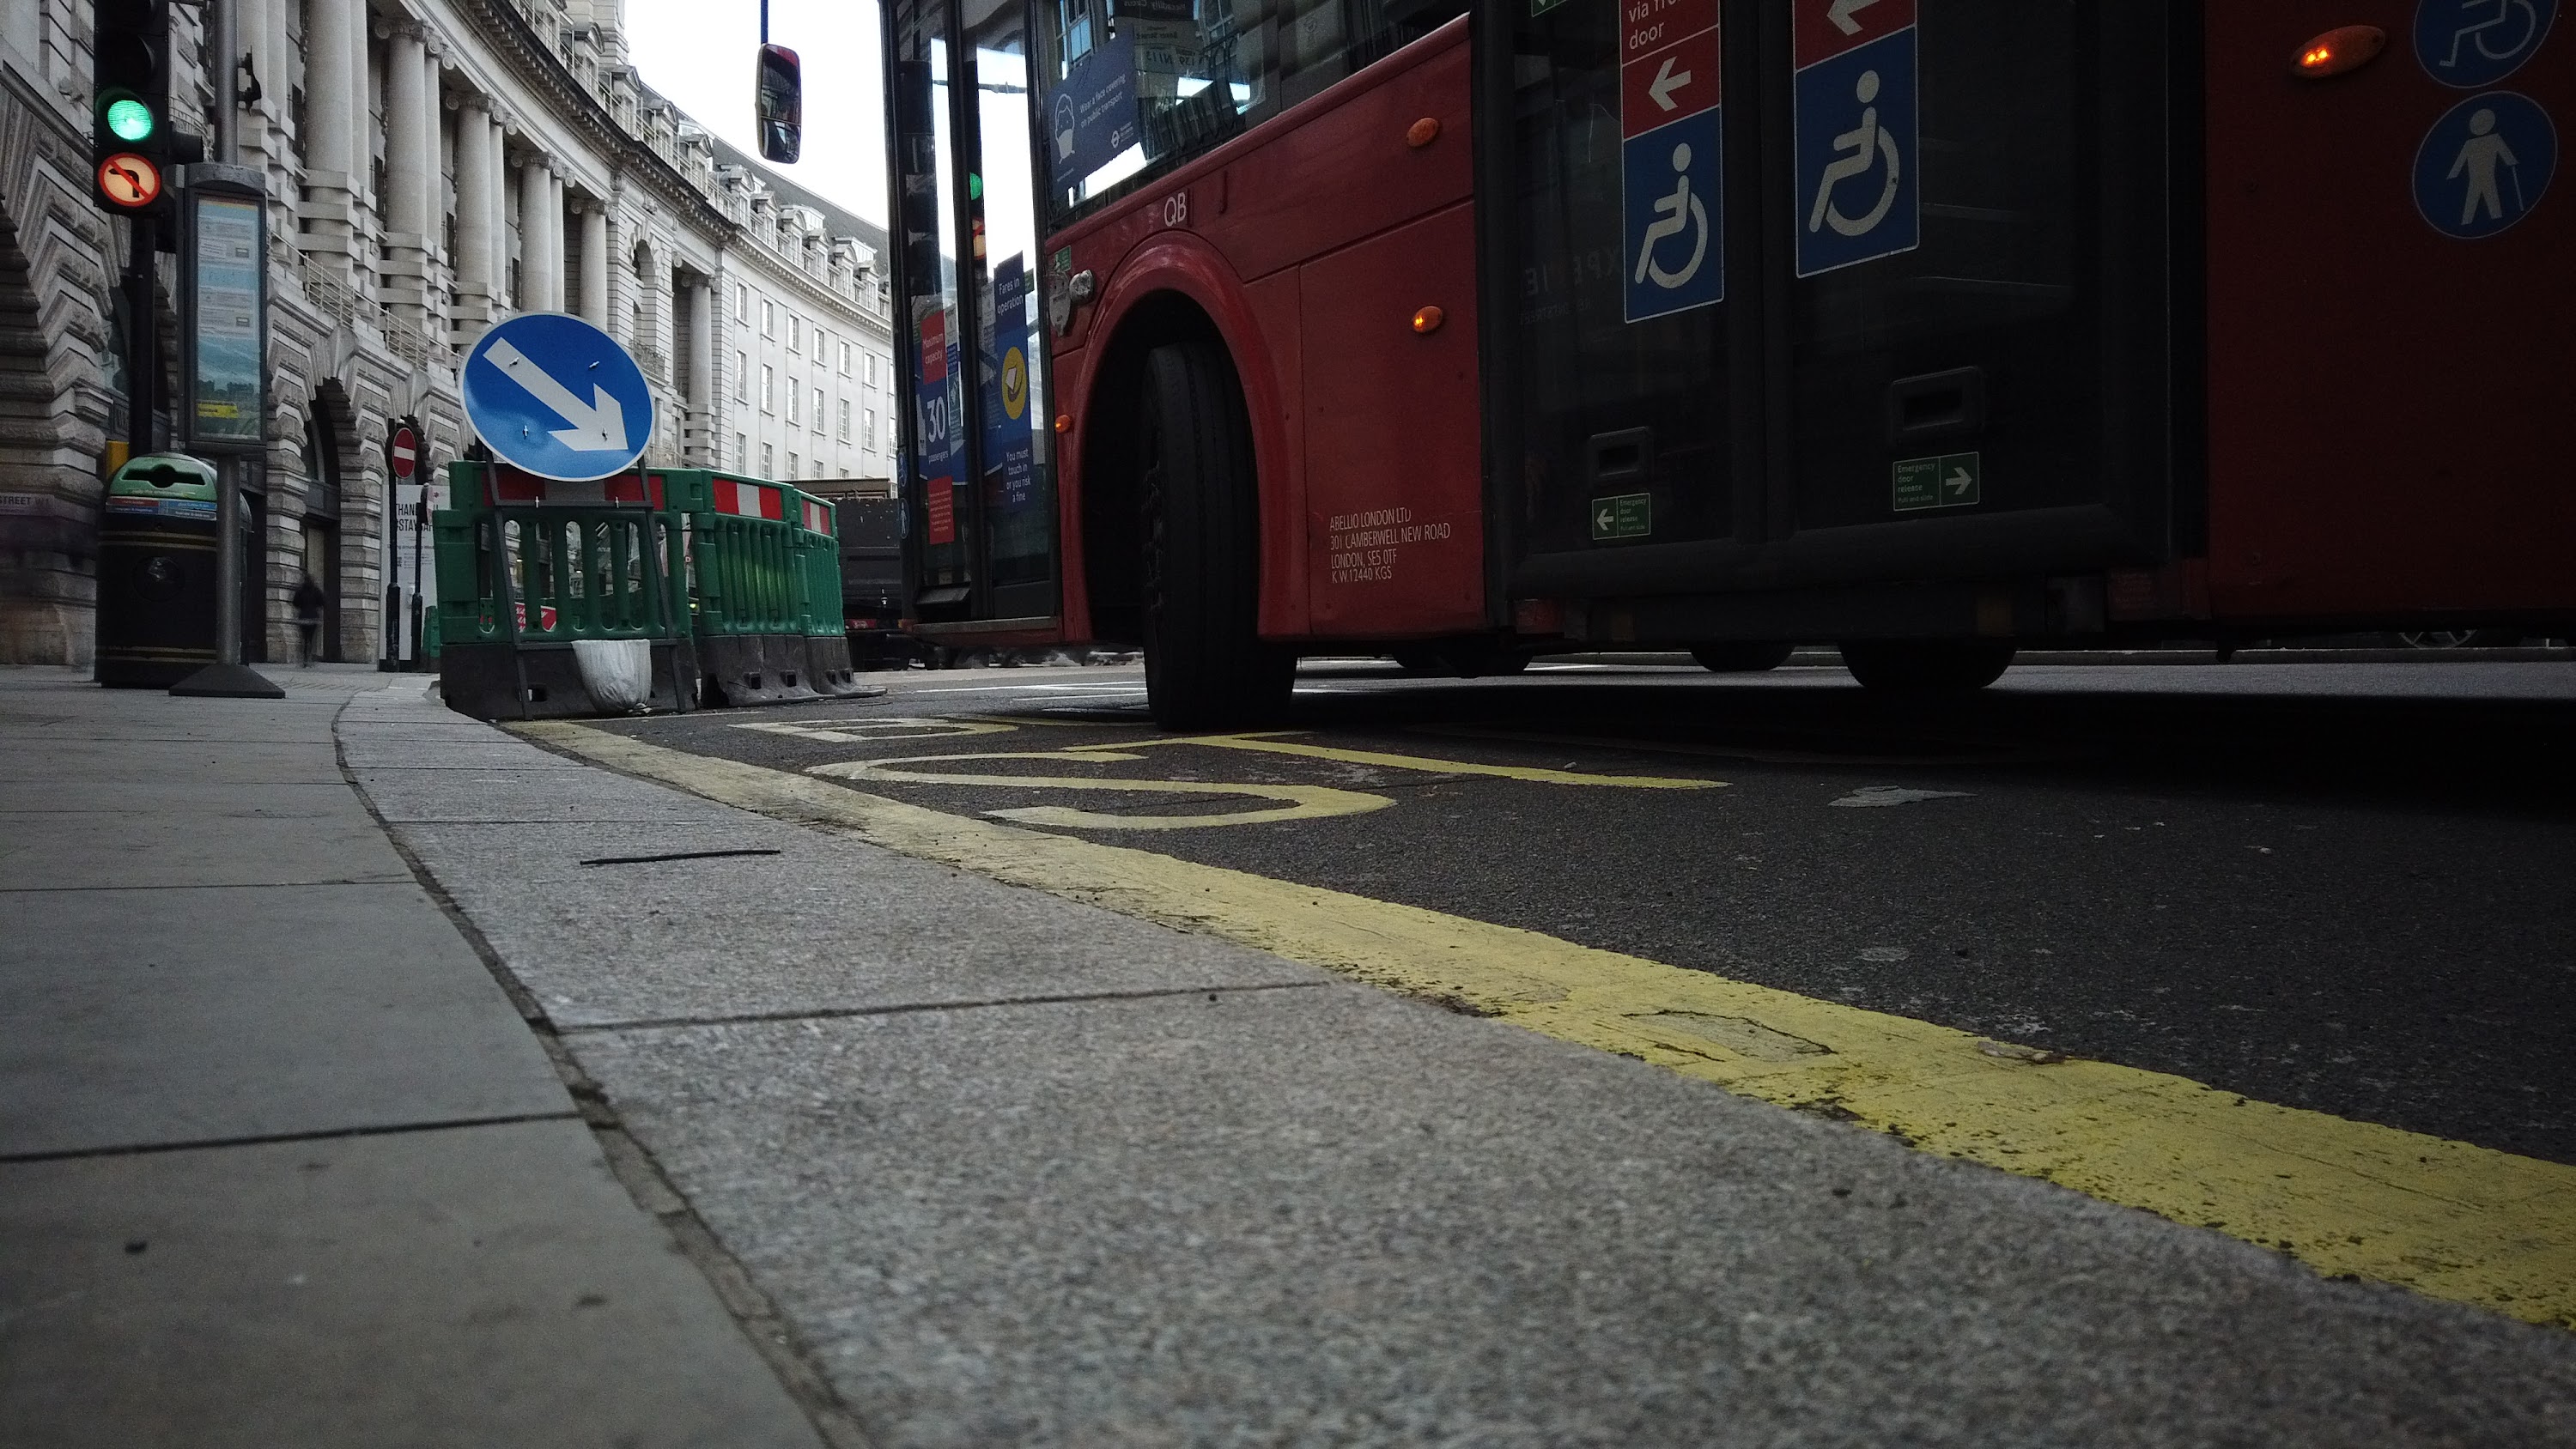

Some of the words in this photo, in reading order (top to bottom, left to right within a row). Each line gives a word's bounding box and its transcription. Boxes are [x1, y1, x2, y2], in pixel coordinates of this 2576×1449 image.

[1628, 2, 1649, 23] via
[1629, 22, 1665, 50] door
[1079, 102, 1091, 114] Wear
[1095, 88, 1106, 103] face
[1105, 73, 1126, 94] covering
[1087, 106, 1102, 126] public
[1101, 91, 1123, 113] transport
[1163, 191, 1187, 227] QB
[999, 280, 1013, 296] Fares
[1014, 276, 1021, 288] in
[997, 294, 1024, 316] operation
[922, 333, 944, 350] Maximum
[924, 349, 943, 366] capacity
[927, 396, 946, 443] 30
[928, 450, 949, 464] passengers
[1005, 451, 1016, 462] You
[1016, 448, 1029, 461] must
[1007, 464, 1022, 476] touch
[1022, 464, 1028, 472] in
[1898, 462, 1935, 473] Emergency
[1005, 480, 1012, 490] or
[1012, 477, 1022, 491] you
[1022, 475, 1031, 487] risk
[1898, 484, 1923, 493] release
[1016, 491, 1026, 502] fine
[1619, 498, 1647, 506] Emergency
[1329, 513, 1358, 531] ABELLIO
[1360, 508, 1394, 528] LONDON
[1396, 506, 1412, 524] LTD
[1330, 535, 1343, 550] 301
[1345, 528, 1399, 549] CAMBERWELL
[1400, 525, 1421, 543] NEW
[1424, 522, 1451, 541] ROAD
[1331, 552, 1365, 569] LONDON,
[1367, 549, 1381, 566] SE5
[1375, 566, 1392, 580] KGS
[726, 712, 1157, 743] BU
